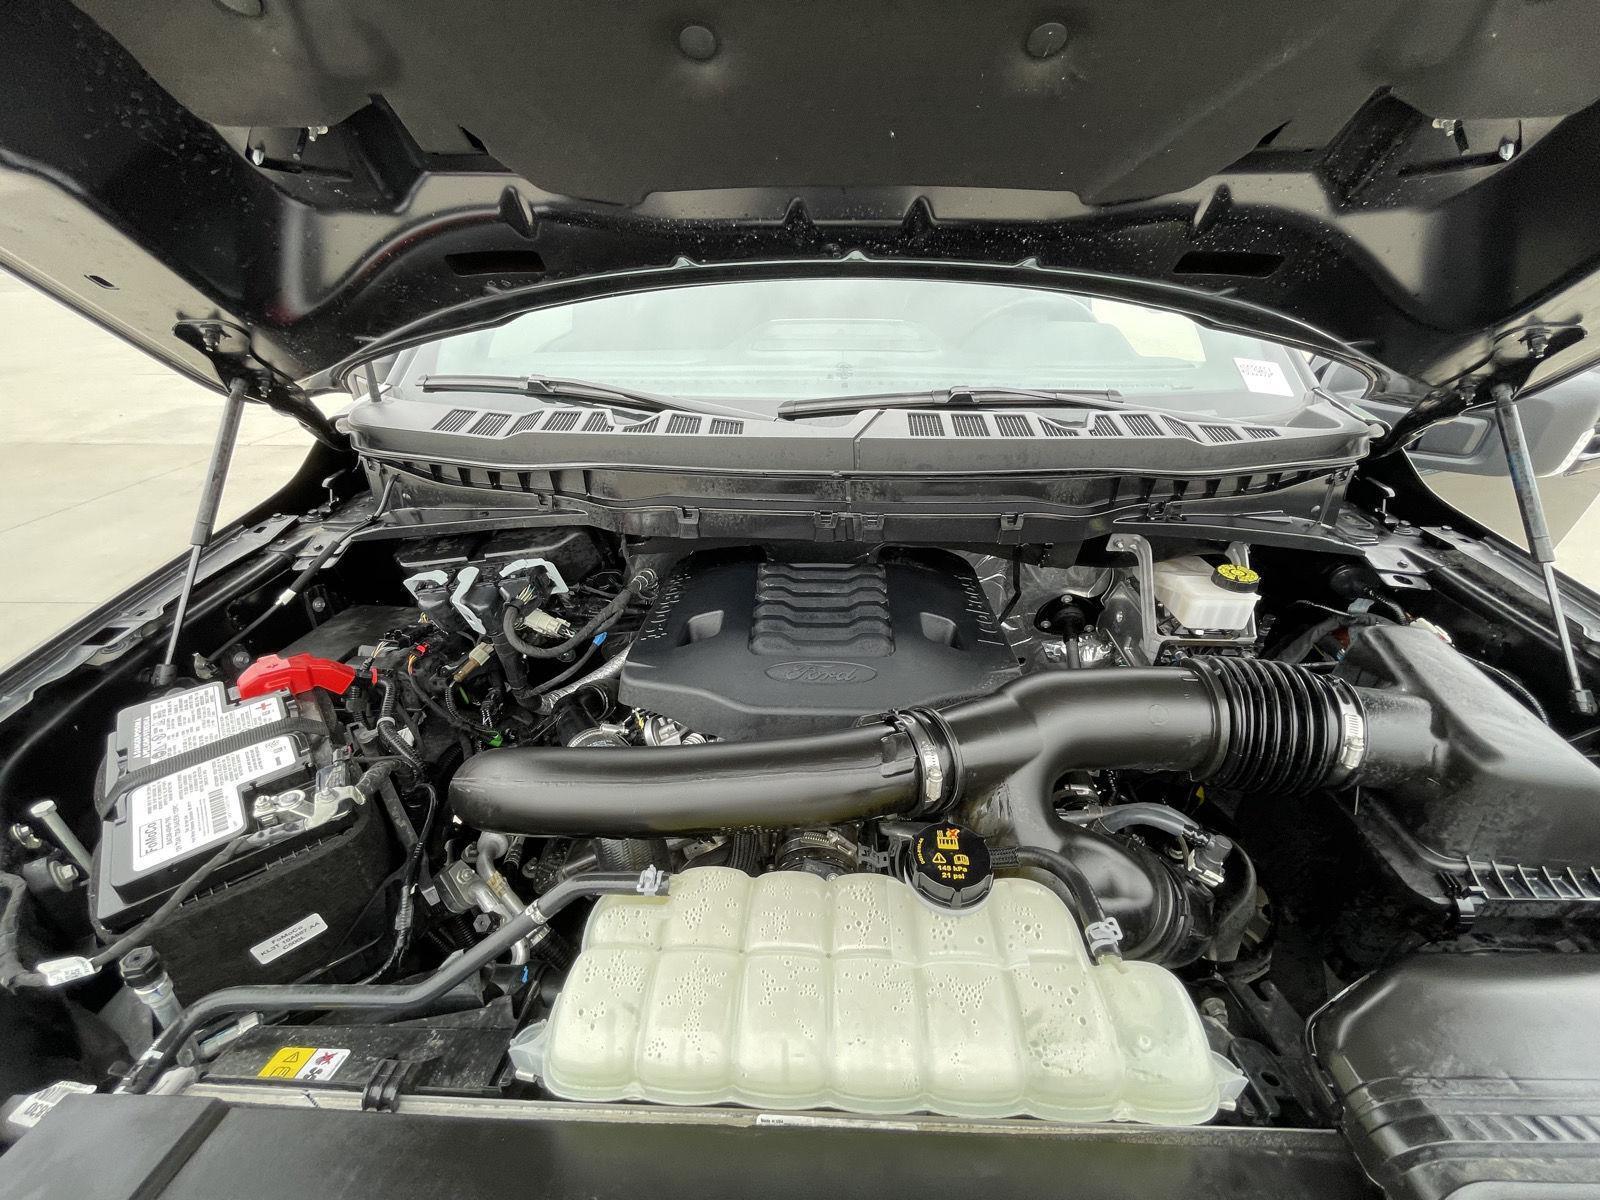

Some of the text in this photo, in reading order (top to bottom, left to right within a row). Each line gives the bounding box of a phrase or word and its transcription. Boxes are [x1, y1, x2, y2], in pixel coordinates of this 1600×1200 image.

[785, 663, 857, 682] Ford
[144, 822, 157, 855] FoMoCo
[952, 865, 968, 873] kPa
[271, 926, 303, 944] FoMoCo
